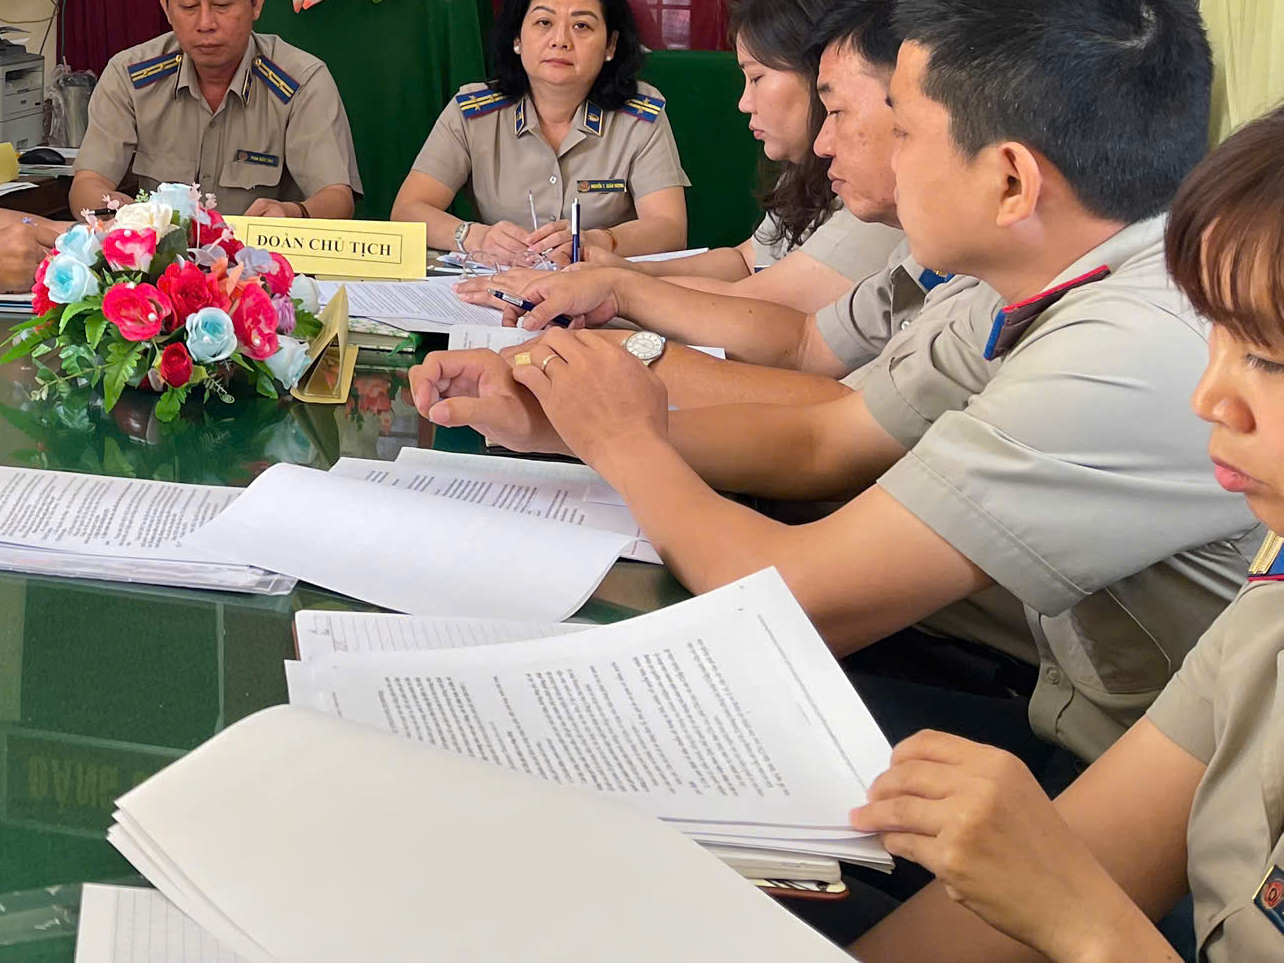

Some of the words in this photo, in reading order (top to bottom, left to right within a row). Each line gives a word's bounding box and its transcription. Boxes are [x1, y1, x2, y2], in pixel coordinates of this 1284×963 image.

[257, 233, 304, 249] ĐOÀN
[309, 237, 345, 252] CHỦ
[350, 241, 392, 257] TỊCH
